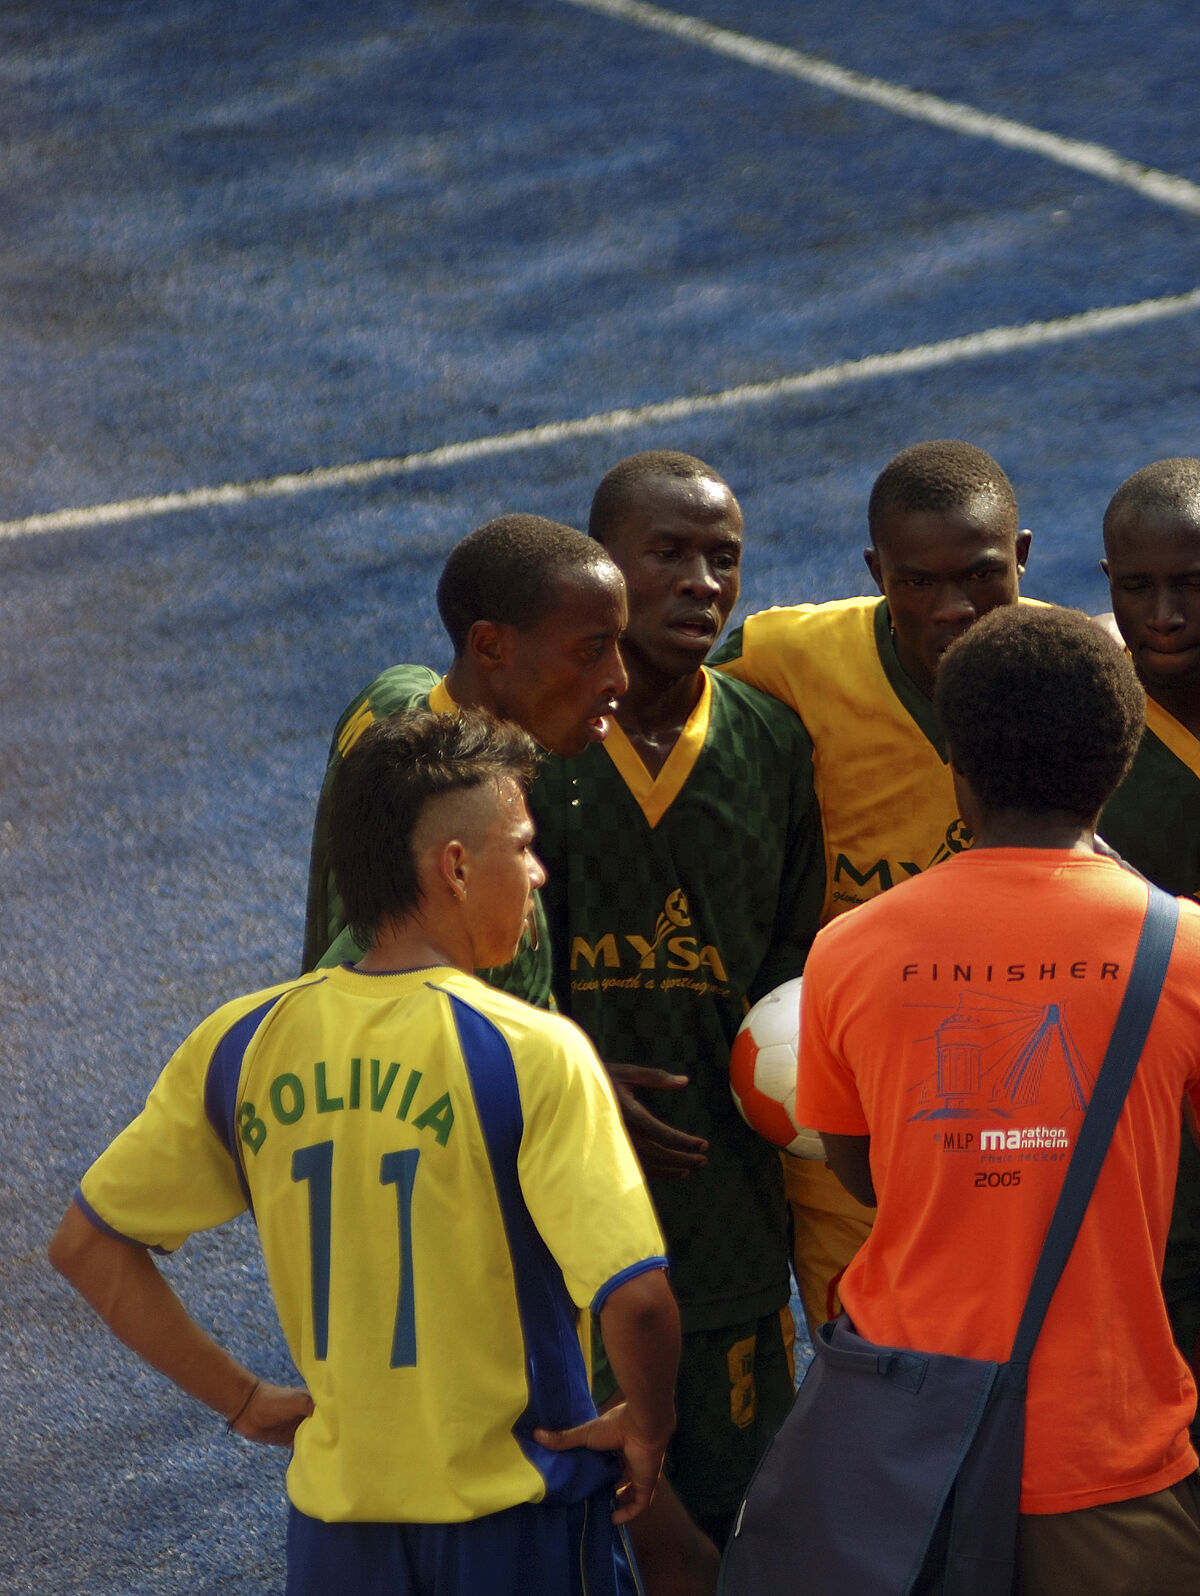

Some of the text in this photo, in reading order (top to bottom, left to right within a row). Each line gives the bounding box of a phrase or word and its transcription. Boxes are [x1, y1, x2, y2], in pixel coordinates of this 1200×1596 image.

[570, 933, 728, 982] MYSA
[902, 961, 1120, 982] FINISHER
[644, 978, 656, 990] a
[238, 1058, 455, 1157] BOLIVIA
[943, 1132, 975, 1150] MLP
[974, 1170, 1022, 1188] 2005
[291, 1140, 421, 1370] 11
